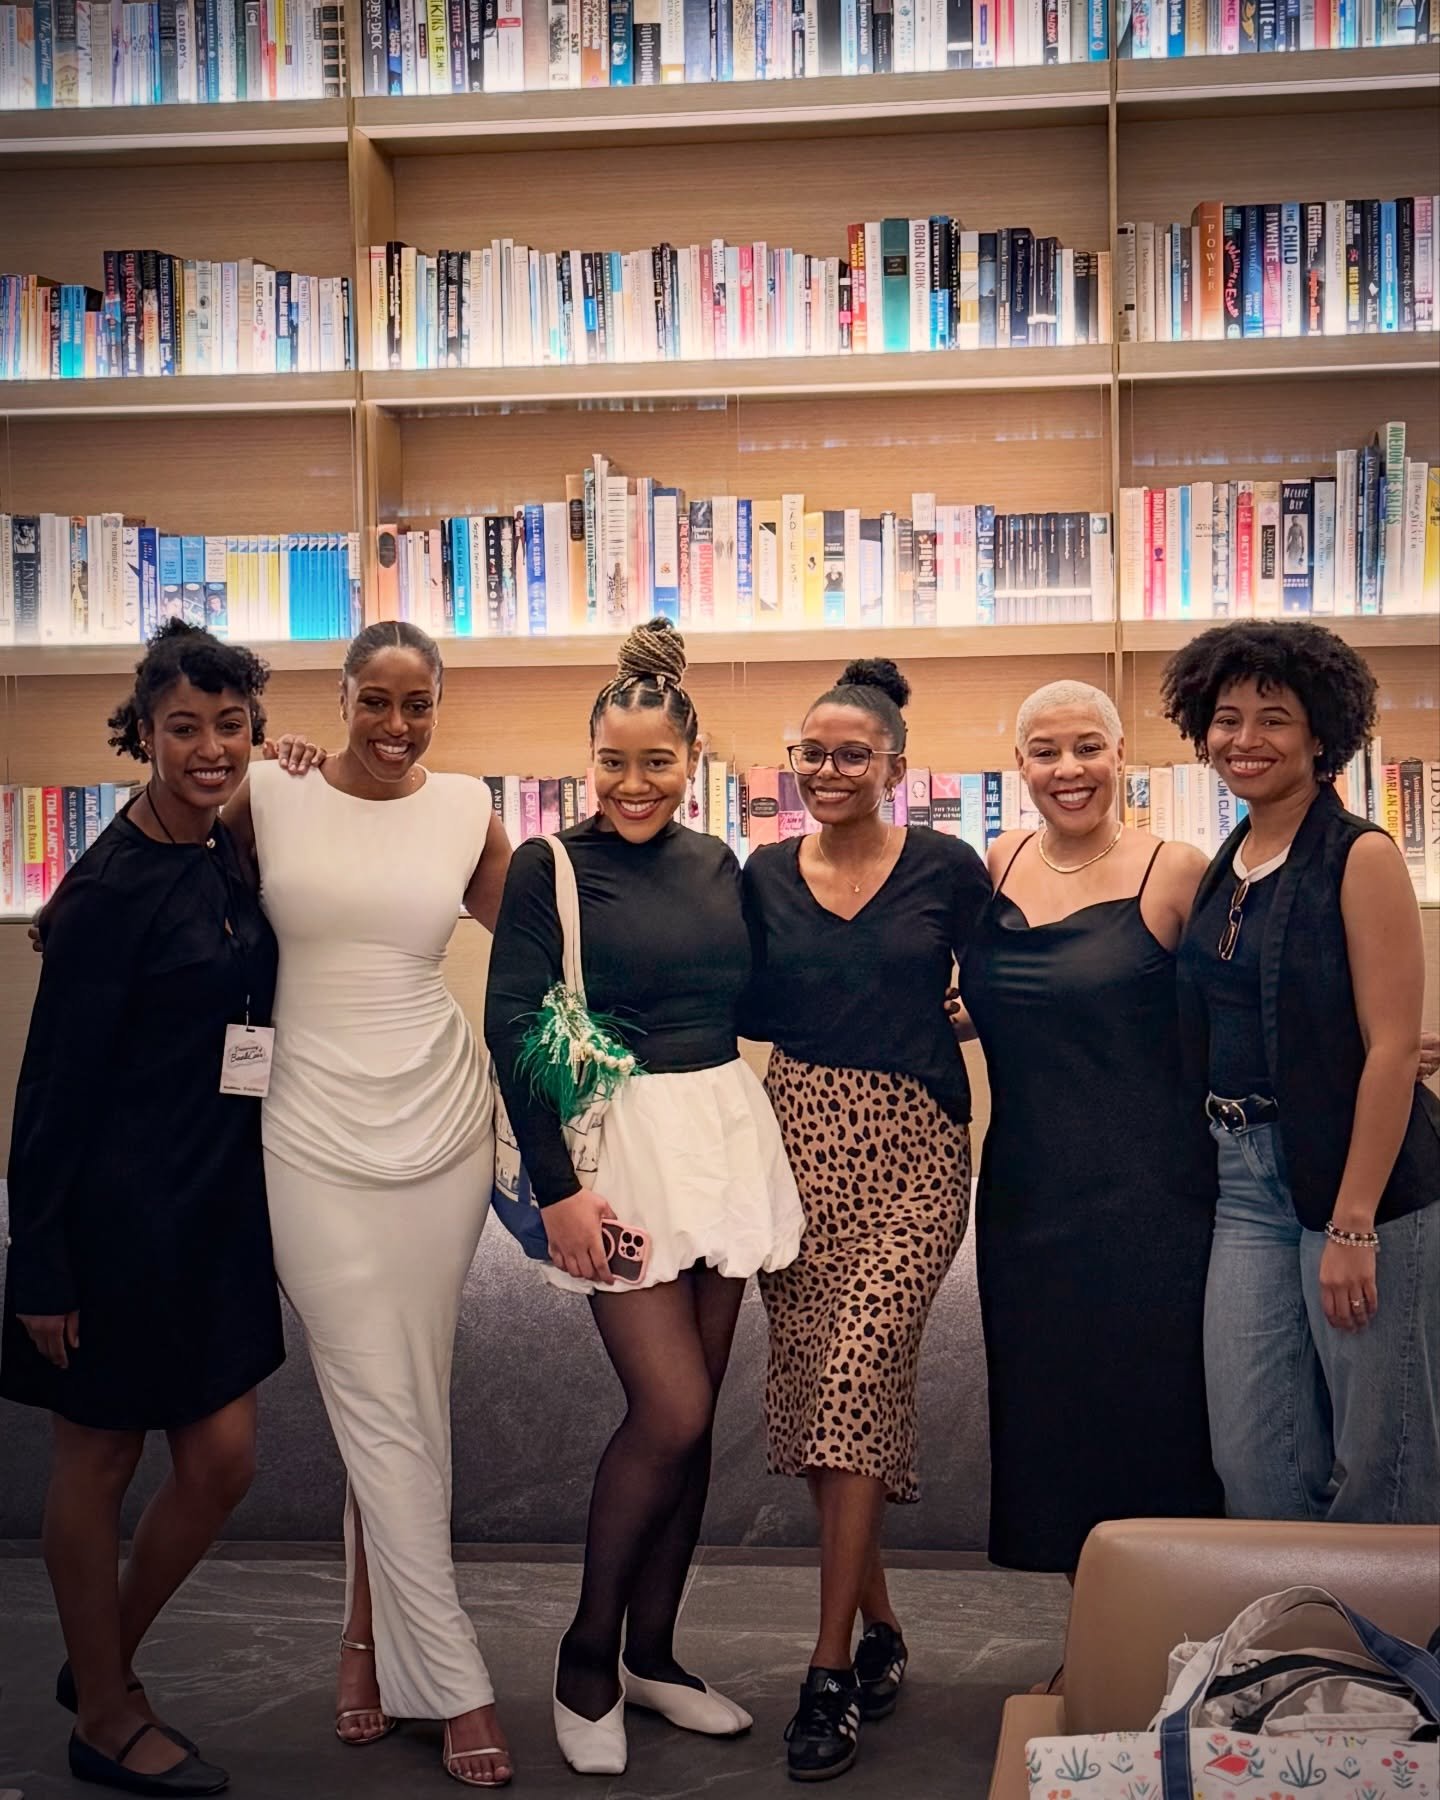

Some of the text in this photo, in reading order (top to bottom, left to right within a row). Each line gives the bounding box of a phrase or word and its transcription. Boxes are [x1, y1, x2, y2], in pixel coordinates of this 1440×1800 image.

[571, 33, 579, 56] SAT
[1249, 210, 1257, 243] STUART
[1266, 222, 1279, 263] WHITE
[1284, 210, 1298, 265] THE CHILD
[1307, 204, 1323, 248] Griffin
[126, 253, 137, 275] CLIVE
[914, 224, 926, 290] ROBIN COOK
[1207, 223, 1217, 292] POWER
[126, 278, 138, 313] CUSSLER
[1402, 254, 1412, 304] REYNOLDS
[256, 281, 265, 326] LEE CHILD
[1387, 427, 1404, 526] AVEDON THE SIXTIES
[1152, 493, 1165, 546] BRAINSTORM
[1241, 535, 1250, 569] BETTY
[85, 793, 97, 817] JACK
[1386, 768, 1398, 807] HARLAN
[29, 832, 38, 861] PARKER
[46, 793, 58, 860] TOM CLANCY
[69, 808, 78, 848] GRAFTON
